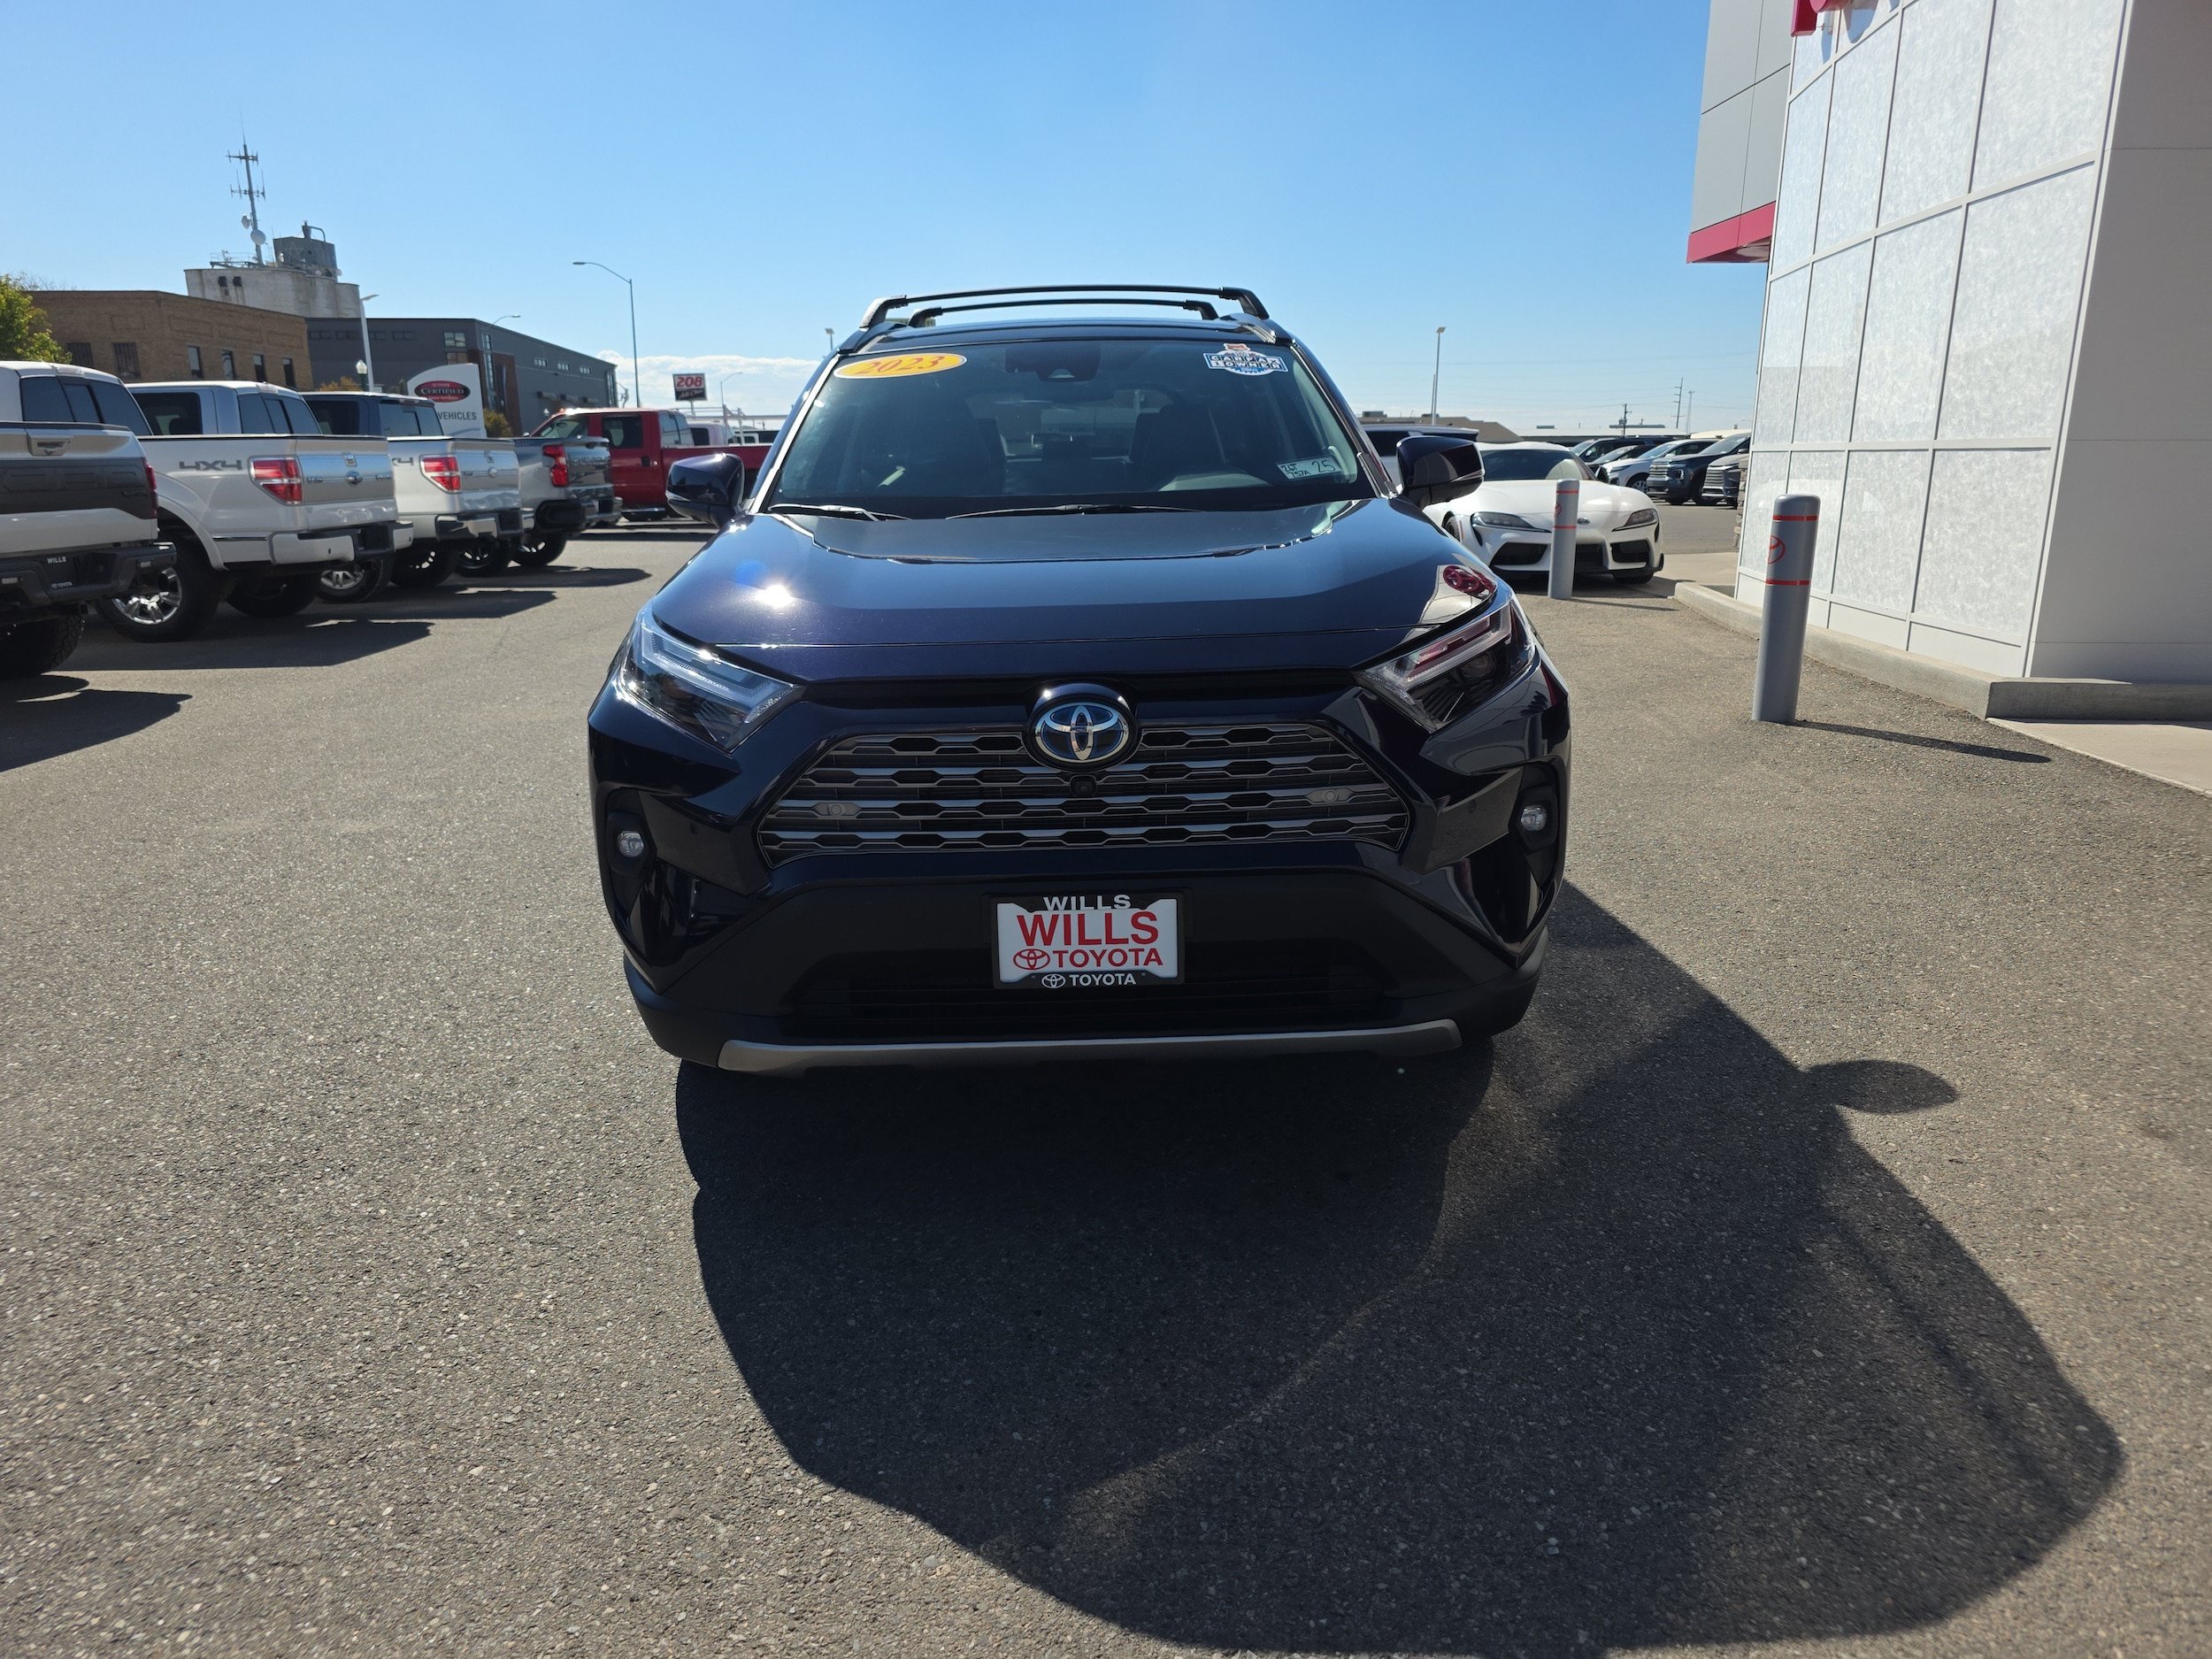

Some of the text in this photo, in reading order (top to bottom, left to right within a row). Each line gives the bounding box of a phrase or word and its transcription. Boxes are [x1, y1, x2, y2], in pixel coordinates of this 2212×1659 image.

[854, 356, 945, 375] 2023
[1210, 356, 1279, 365] CARFAX
[677, 376, 703, 388] 208
[438, 411, 478, 420] VEHICLES
[179, 459, 242, 471] 4X4
[1311, 459, 1336, 473] 25
[1043, 894, 1132, 911] WILLS
[1016, 910, 1159, 947] WILLS
[1052, 948, 1164, 968] TOYOTA
[1069, 973, 1136, 987] TOYOTA
